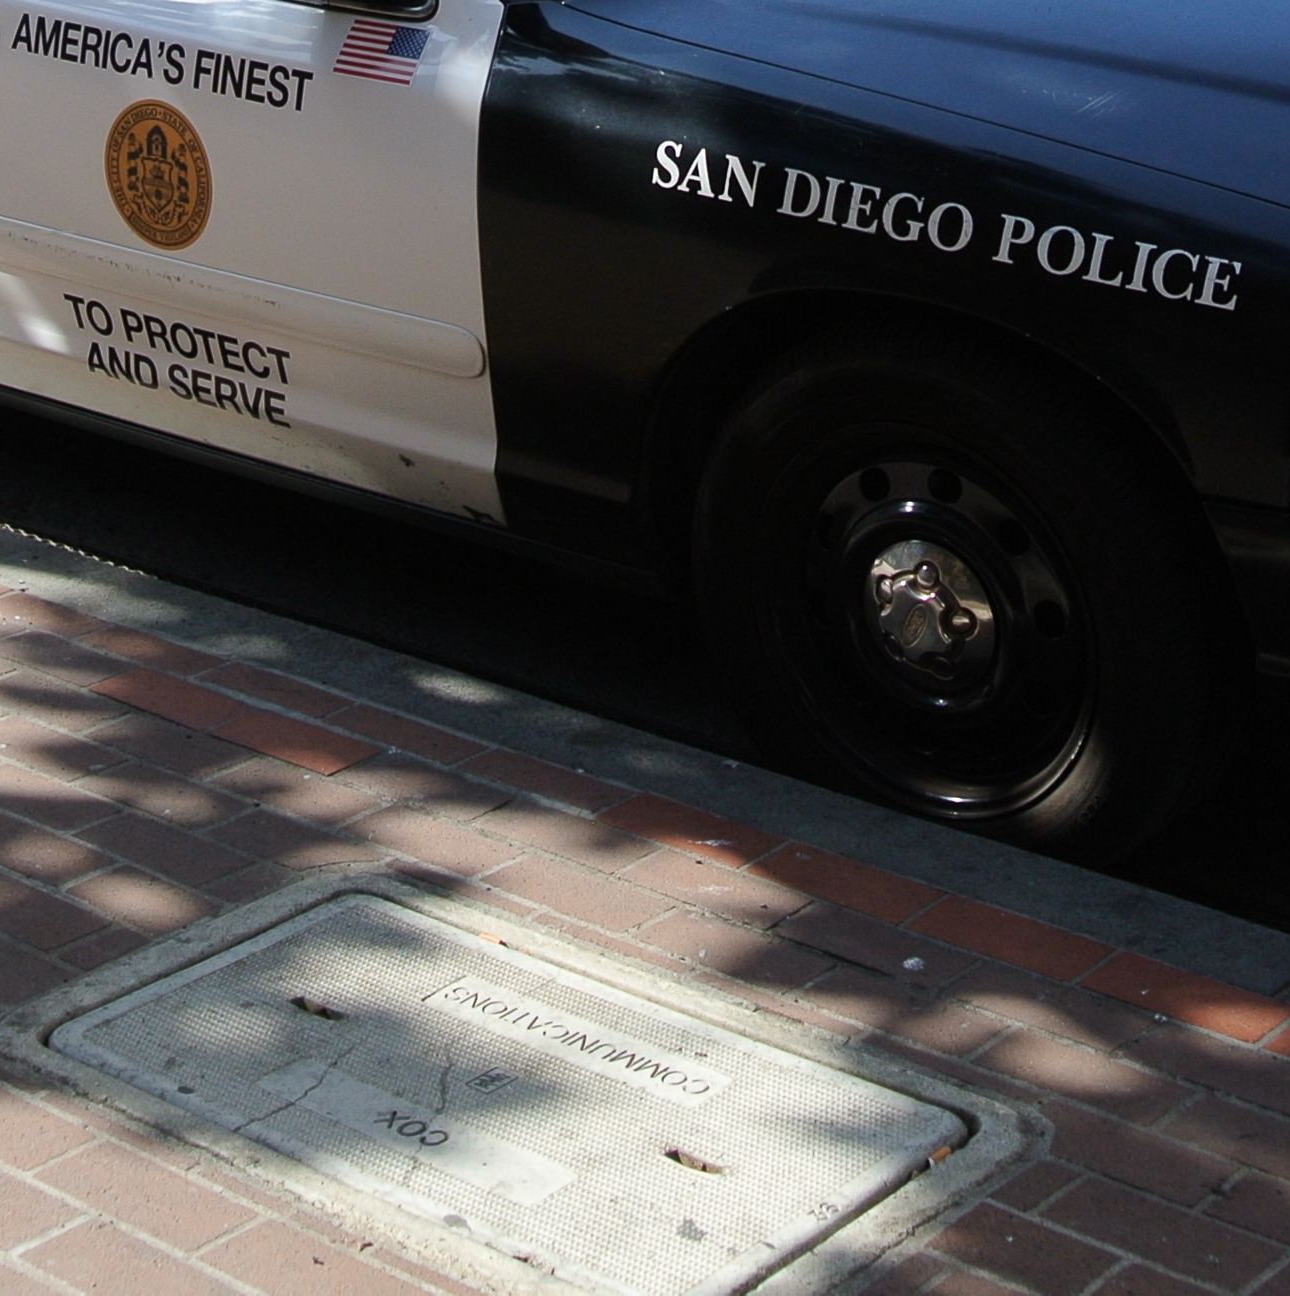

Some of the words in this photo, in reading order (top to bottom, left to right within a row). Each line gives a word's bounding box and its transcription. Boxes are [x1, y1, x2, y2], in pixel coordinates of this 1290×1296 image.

[11, 12, 184, 87] AMERICA'S
[192, 48, 314, 112] FINEST
[131, 107, 158, 124] DIEGO
[651, 140, 767, 208] SAN
[776, 167, 973, 253] DIEGO
[991, 213, 1242, 312] POLICE
[63, 293, 113, 336] TO
[119, 306, 291, 387] PROTECT
[87, 342, 158, 390] AND
[168, 362, 291, 429] SERVE
[444, 984, 711, 1096] COMMUNICATIONS
[374, 1109, 449, 1147] COX
